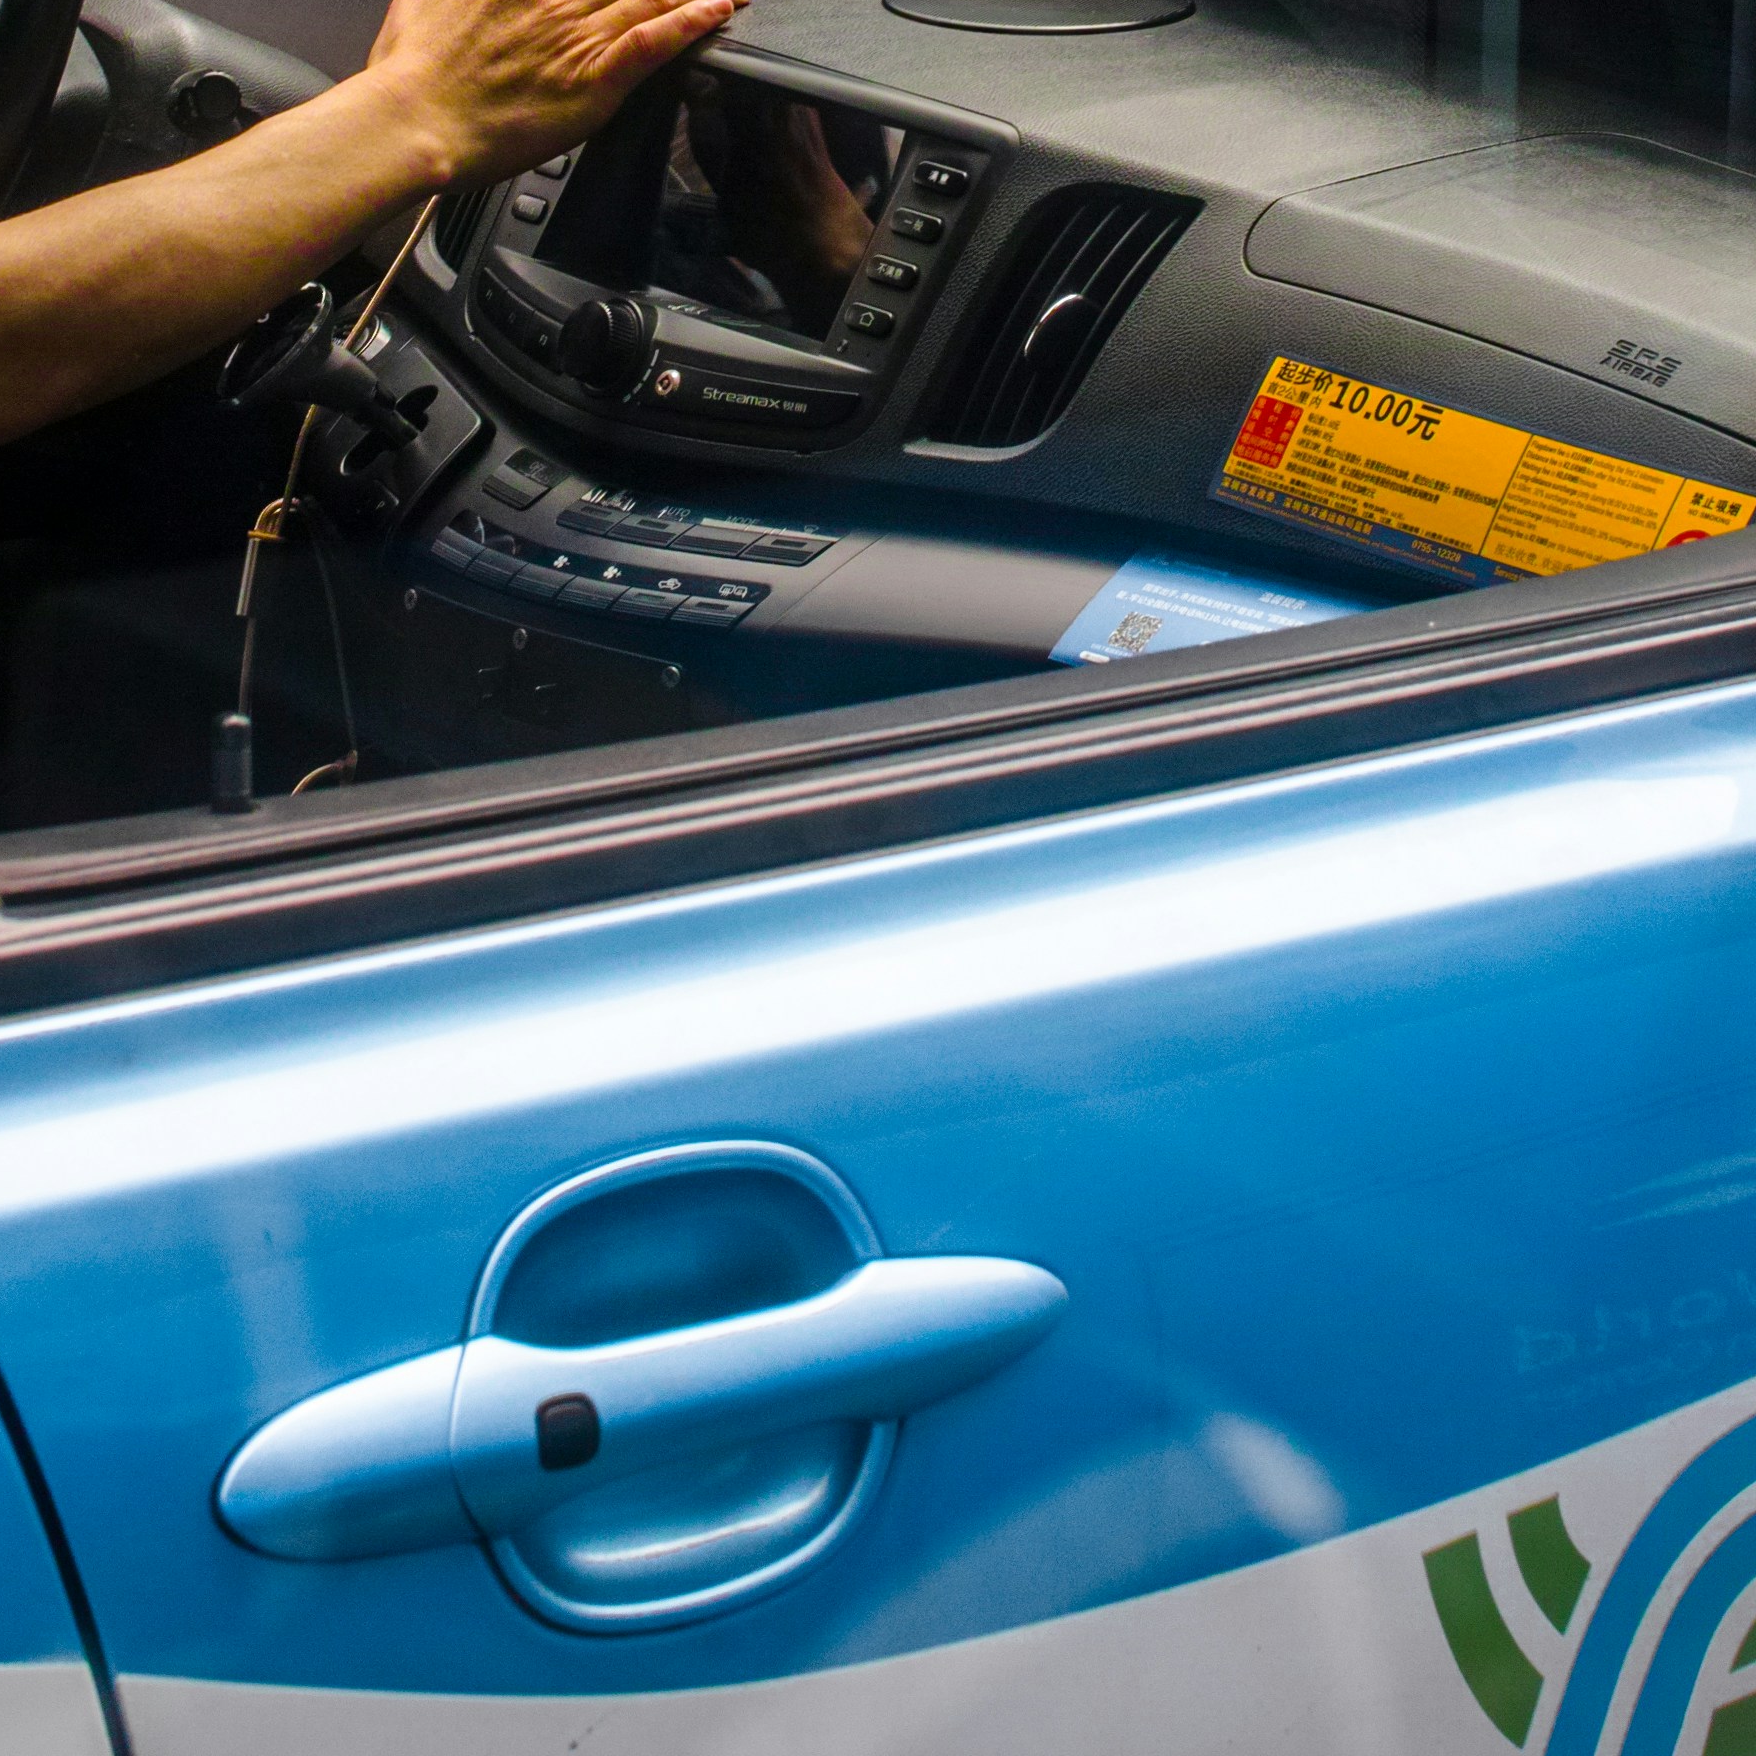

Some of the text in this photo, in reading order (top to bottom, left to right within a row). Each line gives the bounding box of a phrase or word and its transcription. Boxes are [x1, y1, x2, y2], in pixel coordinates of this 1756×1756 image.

[1610, 338, 1682, 374] SRS
[1599, 356, 1669, 388] AIRBAG
[702, 386, 781, 410] Streamax
[1265, 381, 1323, 409] 首2公里内
[1274, 359, 1446, 442] 起步价 10.00元
[1687, 507, 1731, 525] NO SMOKING
[1689, 491, 1742, 517] 禁止吸烟
[1410, 539, 1461, 563] 0755-12328
